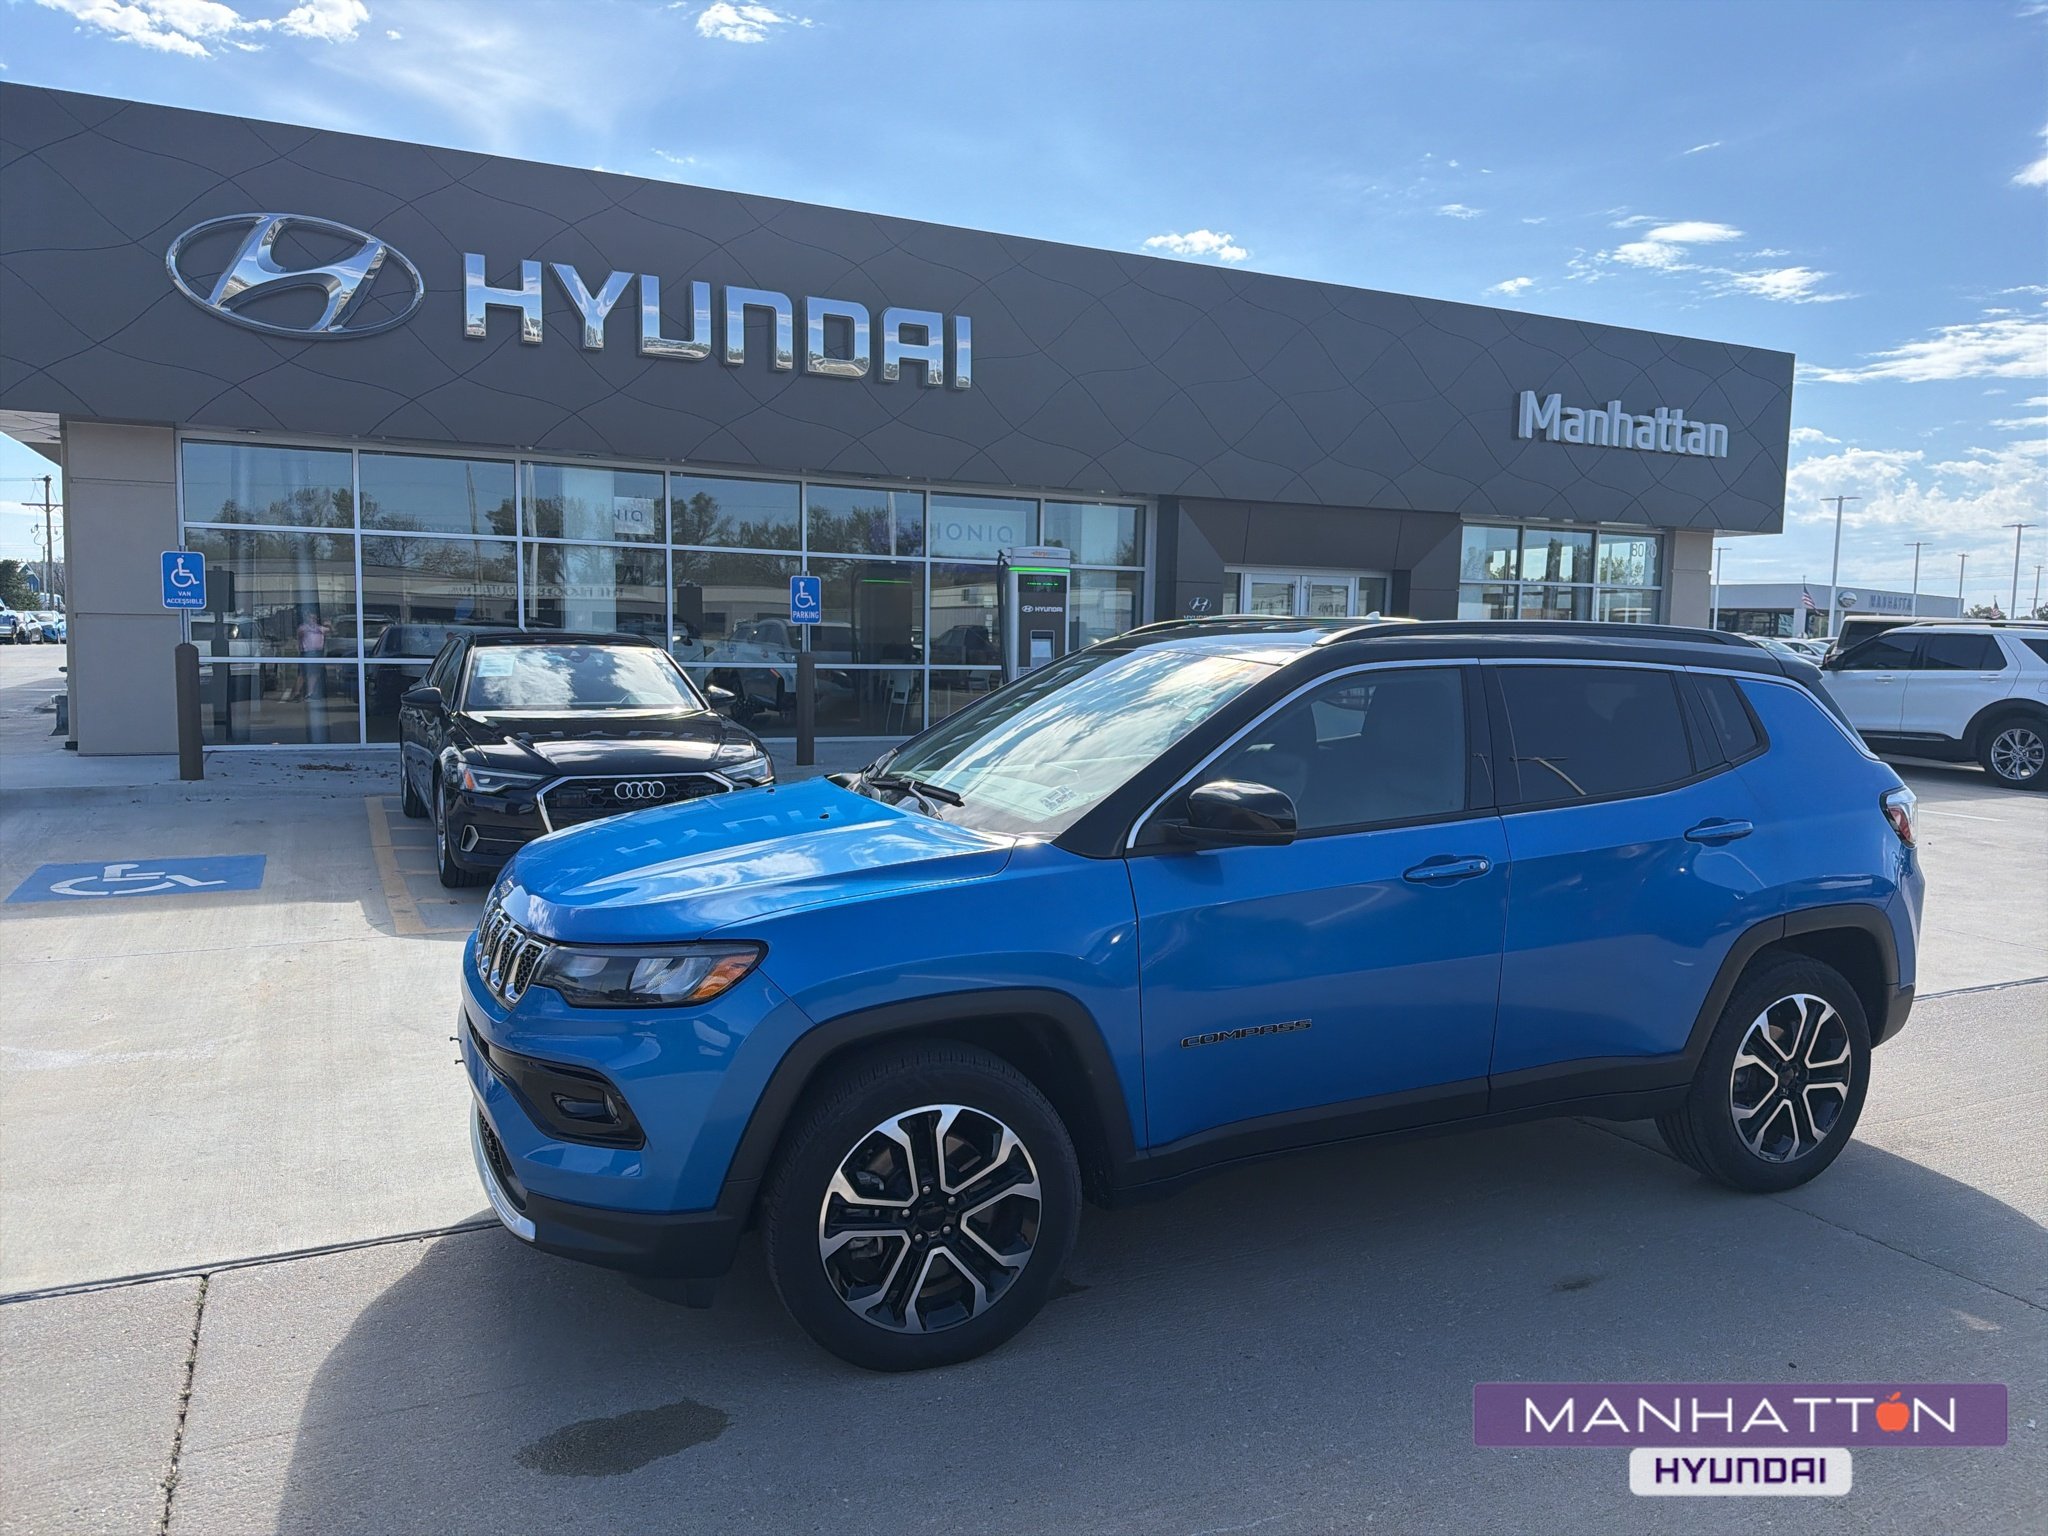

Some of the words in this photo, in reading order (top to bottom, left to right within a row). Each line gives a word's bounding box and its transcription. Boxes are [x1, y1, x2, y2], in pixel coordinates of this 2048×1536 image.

[463, 252, 972, 389] HYUNDAI
[1517, 390, 1729, 458] Manhattan
[937, 522, 1013, 544] IONIQ
[166, 597, 204, 605] ACCESSIBLE
[793, 611, 820, 619] PARKING
[1180, 1018, 1313, 1049] COMPASS
